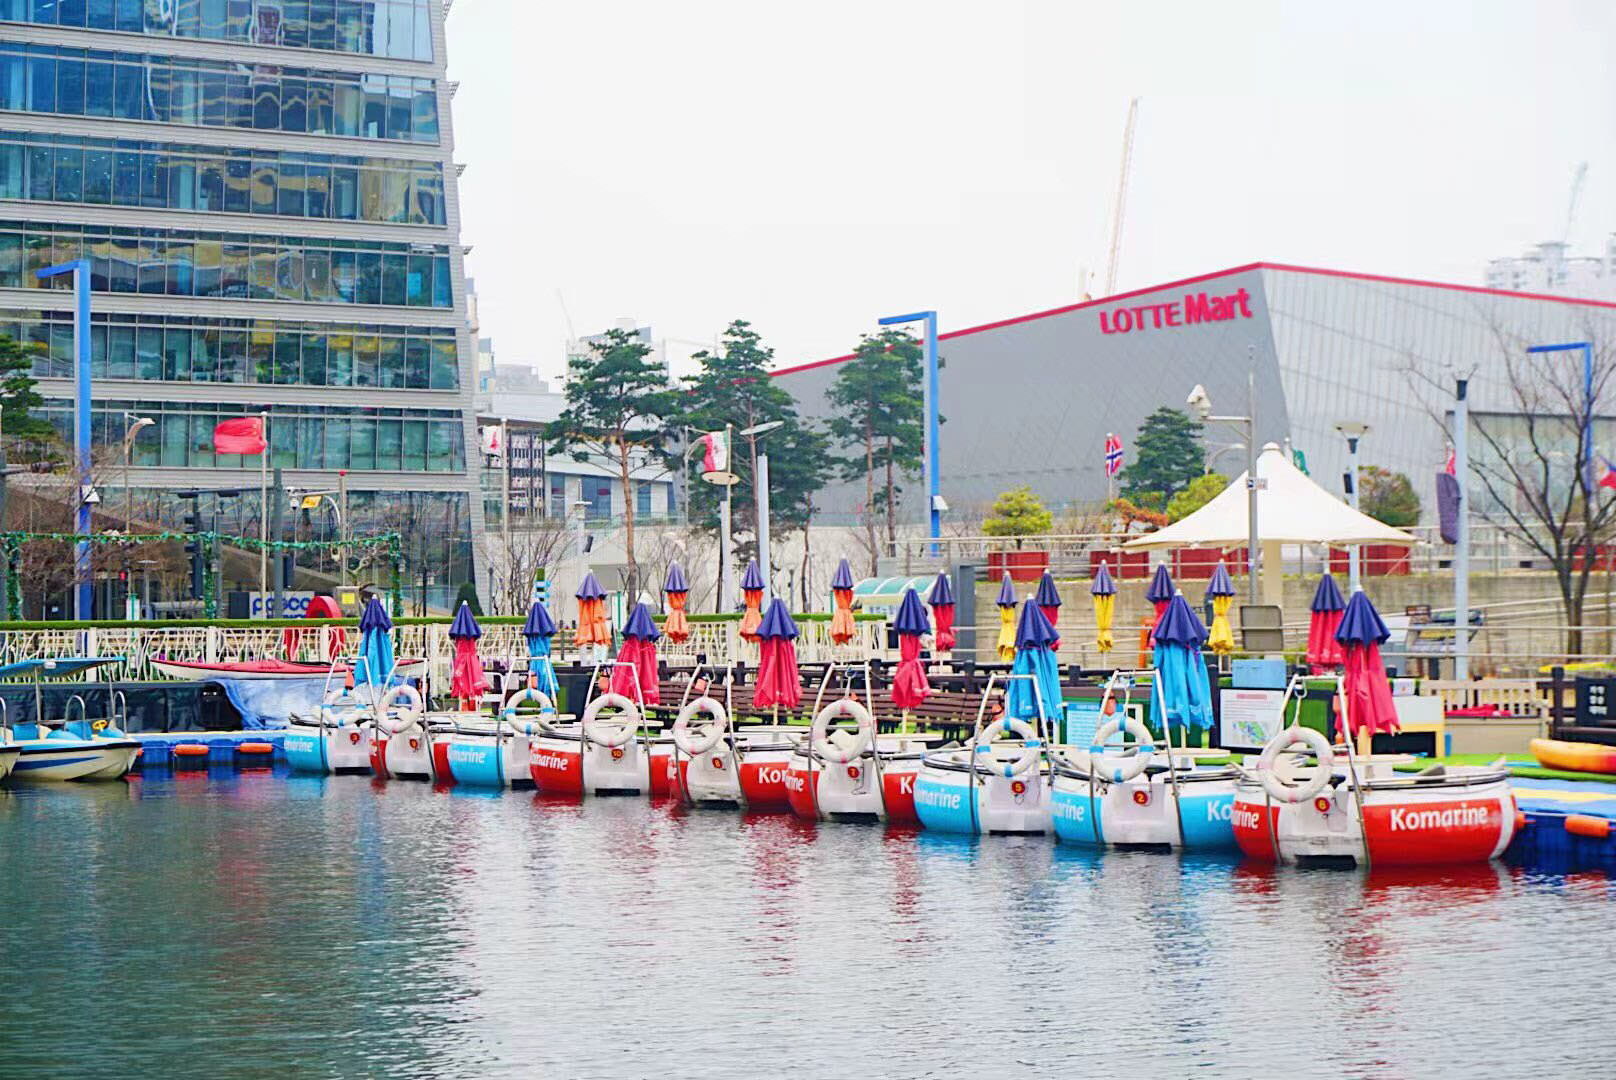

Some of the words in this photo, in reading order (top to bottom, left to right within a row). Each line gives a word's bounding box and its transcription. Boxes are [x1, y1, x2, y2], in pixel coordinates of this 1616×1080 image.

[1099, 302, 1182, 335] LOTTE
[1184, 287, 1253, 325] Mart
[1136, 793, 1145, 803] 2
[1318, 801, 1326, 809] 6
[1389, 803, 1489, 832] Komarine
